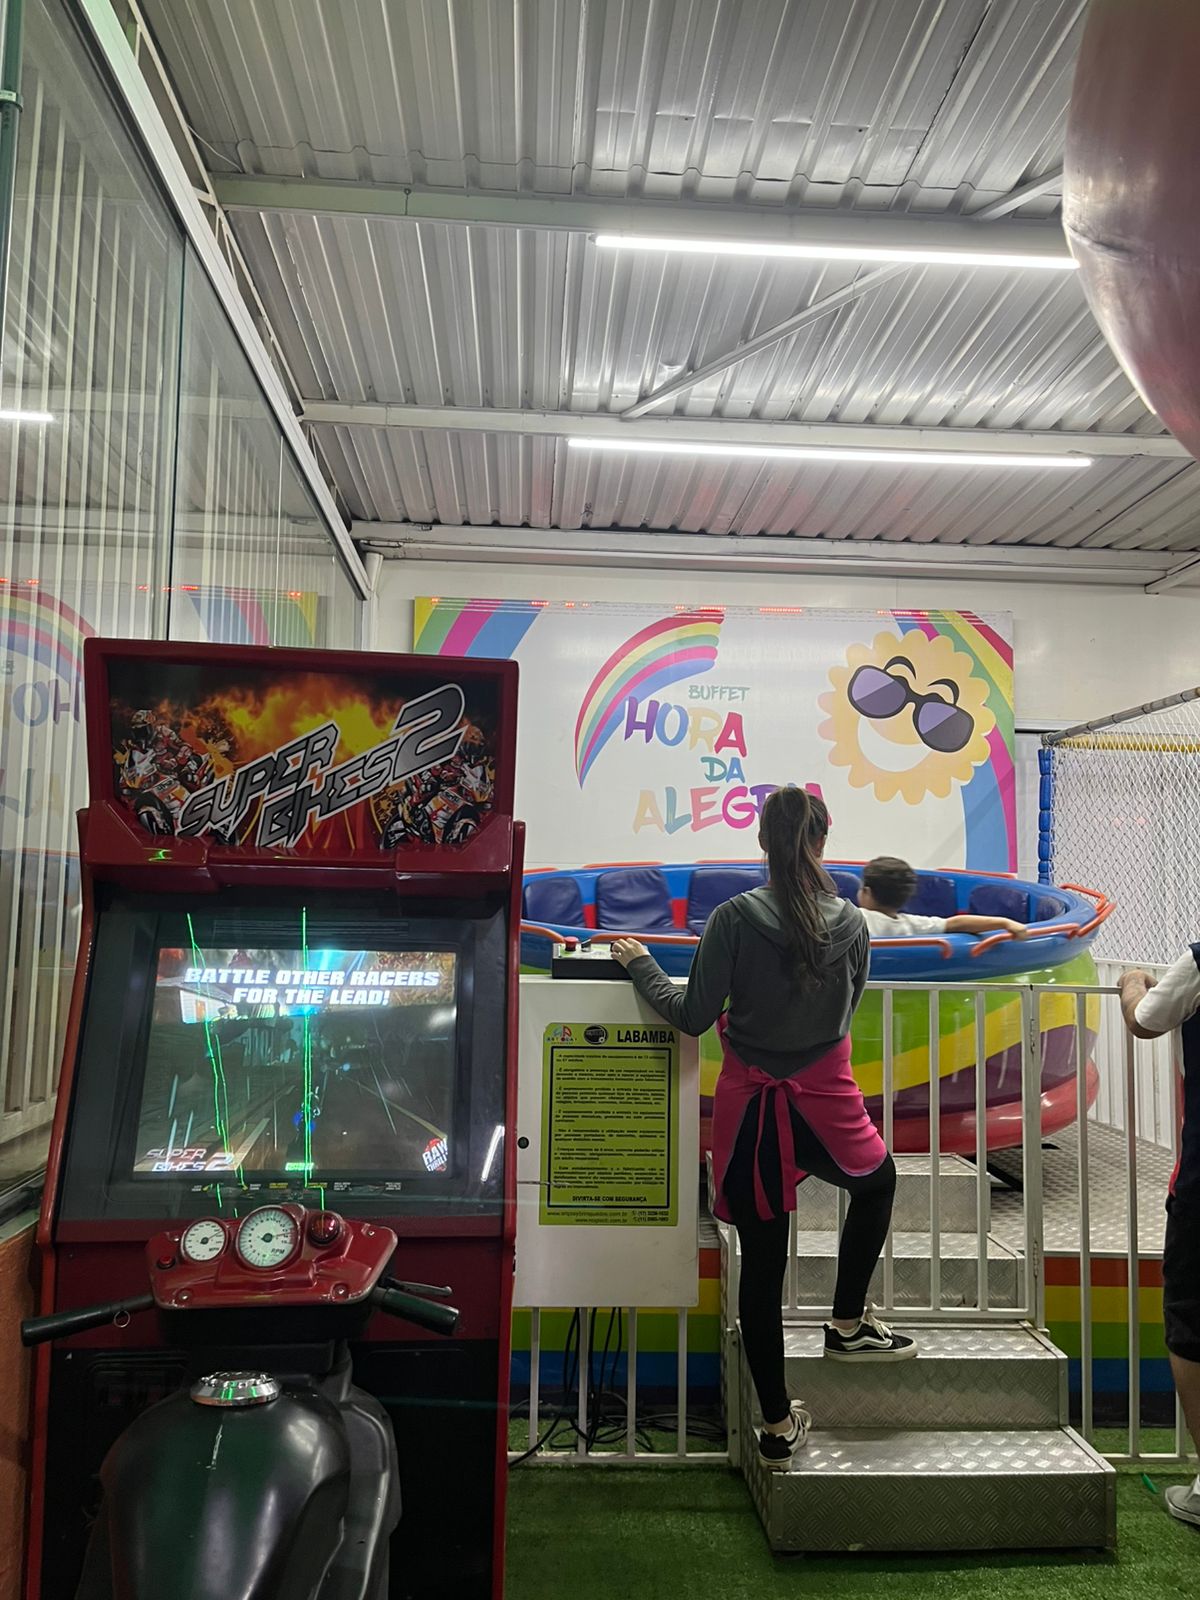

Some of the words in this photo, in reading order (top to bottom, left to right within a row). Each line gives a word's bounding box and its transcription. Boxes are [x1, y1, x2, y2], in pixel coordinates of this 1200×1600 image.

[688, 685, 750, 701] BUFFET
[624, 696, 748, 758] HORA
[255, 736, 401, 848] BIKES
[390, 683, 468, 780] 2
[700, 756, 746, 783] DA
[176, 720, 341, 840] SUPER
[632, 782, 832, 835] ALEG
[184, 968, 271, 985] BATTLE
[276, 970, 345, 986] OTHER
[350, 971, 440, 987] RACERS
[232, 988, 278, 1004] FOR
[285, 989, 325, 1005] THE
[330, 990, 390, 1006] LEAD!
[617, 1030, 675, 1044] LABAMBA
